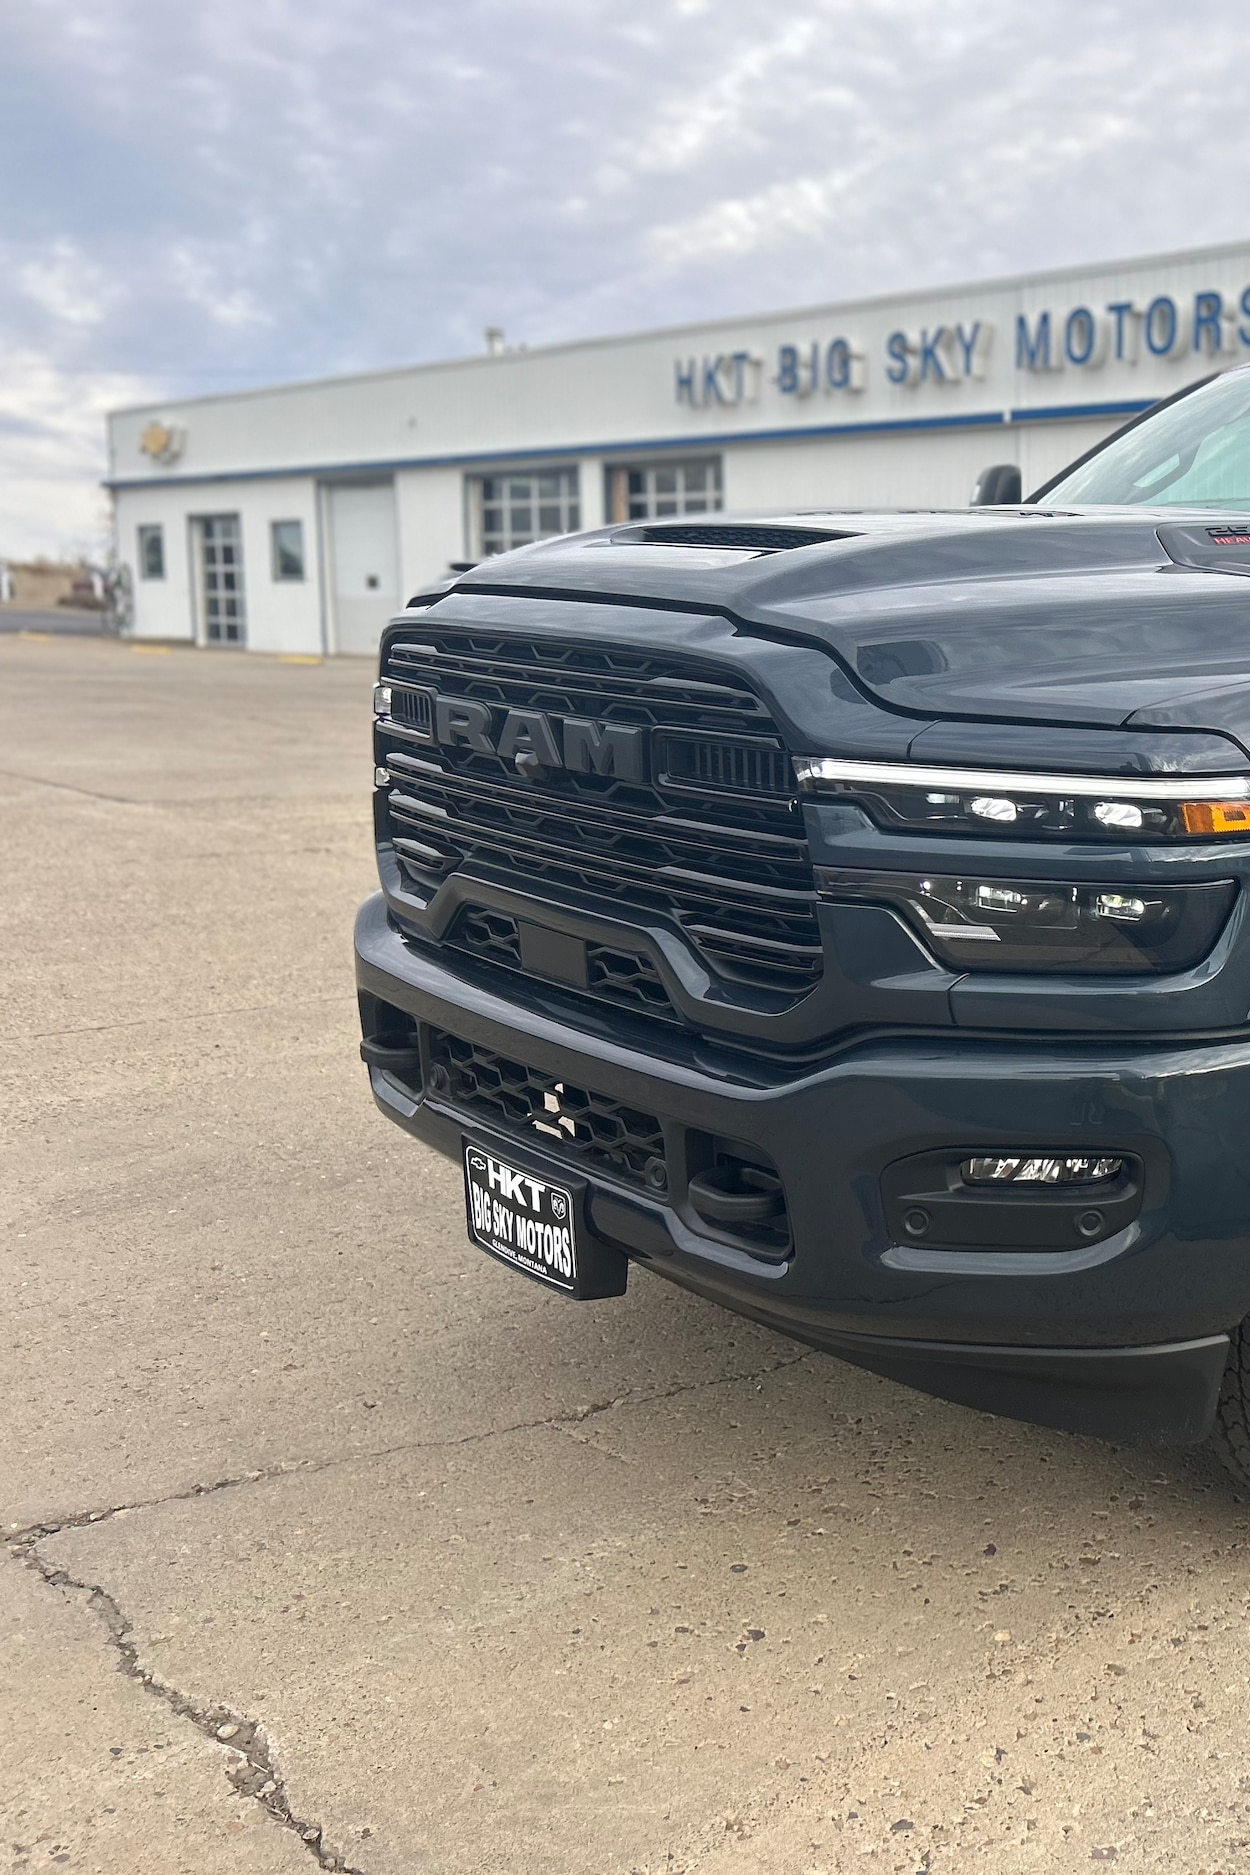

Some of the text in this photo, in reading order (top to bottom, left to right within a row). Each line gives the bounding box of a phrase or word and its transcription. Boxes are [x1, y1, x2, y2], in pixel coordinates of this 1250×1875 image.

[674, 350, 752, 405] HKT
[776, 336, 854, 396] BIG
[884, 321, 984, 385] SKY
[434, 695, 644, 782] RAM
[487, 1158, 546, 1212] HKT
[472, 1181, 572, 1278] BIG SKY MOTORS
[517, 1252, 548, 1275] MONTANA
